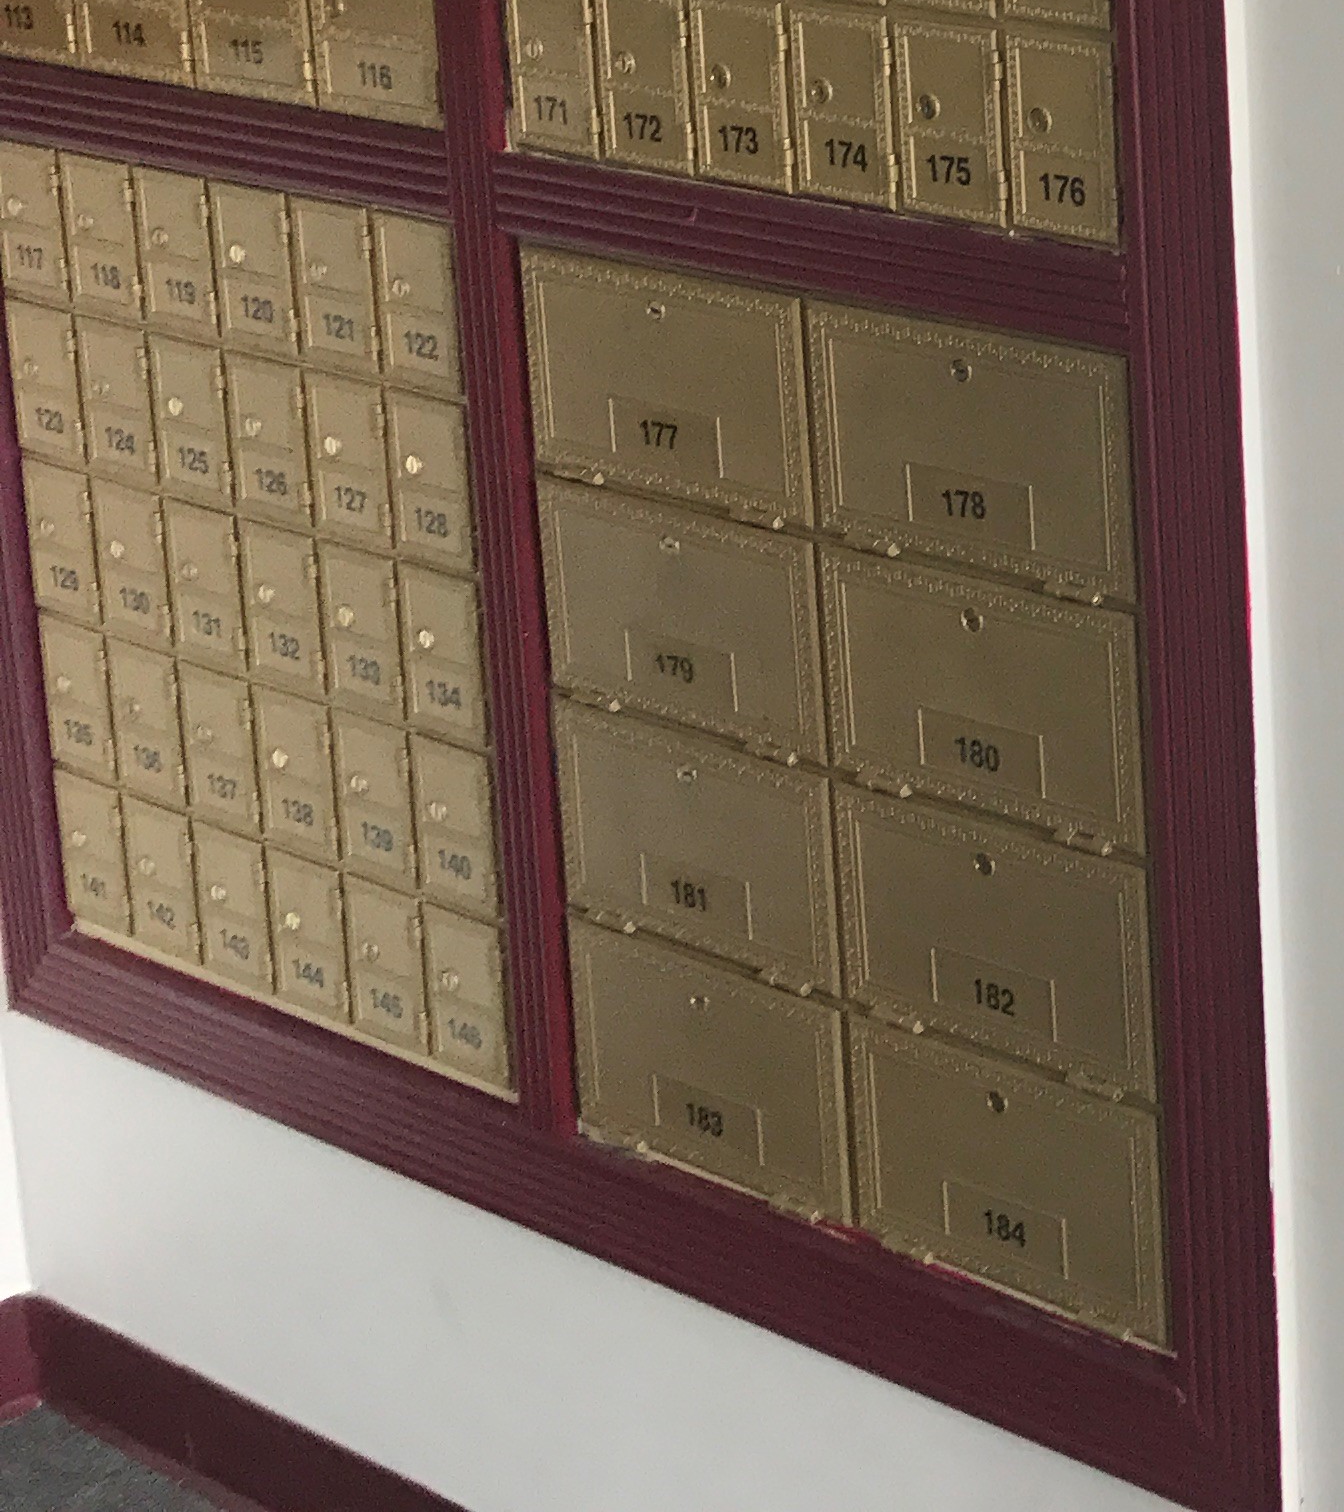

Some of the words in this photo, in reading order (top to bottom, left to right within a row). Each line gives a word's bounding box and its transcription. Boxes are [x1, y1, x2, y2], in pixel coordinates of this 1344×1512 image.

[4, 5, 33, 30] 113
[113, 20, 145, 46] 114
[229, 35, 262, 64] 115
[358, 61, 392, 90] 116
[534, 96, 568, 125] 171
[624, 113, 662, 142] 172
[719, 126, 758, 154] 173
[825, 139, 868, 172] 174
[927, 155, 971, 185] 175
[1040, 173, 1085, 206] 176
[16, 244, 43, 269] 117
[91, 263, 121, 290] 118
[166, 278, 196, 305] 119
[241, 295, 274, 323] 120
[323, 313, 354, 341] 121
[404, 331, 439, 361] 122
[35, 407, 64, 434] 123
[640, 420, 678, 449] 177
[105, 427, 136, 455] 124
[178, 447, 209, 475] 125
[255, 469, 288, 496] 126
[335, 486, 367, 513] 127
[942, 490, 986, 519] 178
[415, 508, 449, 538] 128
[50, 566, 79, 592] 129
[120, 587, 150, 614] 130
[193, 610, 221, 638] 131
[269, 632, 300, 661] 132
[347, 655, 381, 686] 133
[656, 654, 694, 683] 179
[427, 680, 462, 709] 134
[955, 737, 999, 772] 180
[671, 880, 706, 911] 181
[974, 979, 1015, 1016] 182
[687, 1103, 723, 1137] 183
[984, 1210, 1026, 1247] 184
